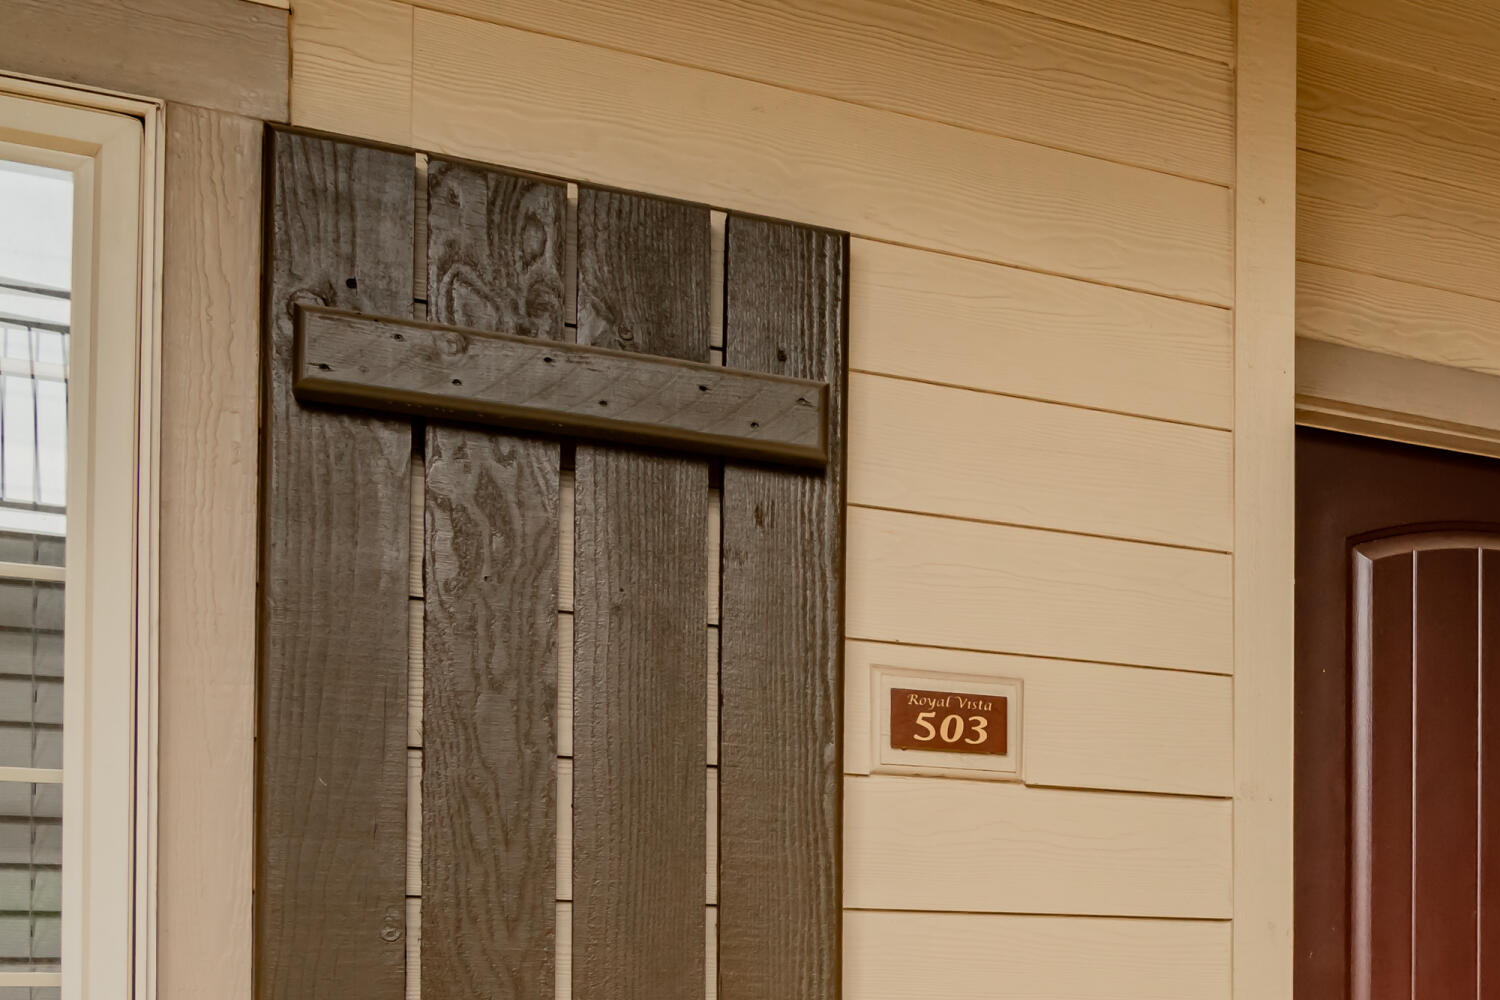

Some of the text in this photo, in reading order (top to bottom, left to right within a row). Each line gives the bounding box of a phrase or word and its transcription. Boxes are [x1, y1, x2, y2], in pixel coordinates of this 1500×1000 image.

[907, 693, 992, 711] Royal Vista
[913, 711, 988, 745] 503
